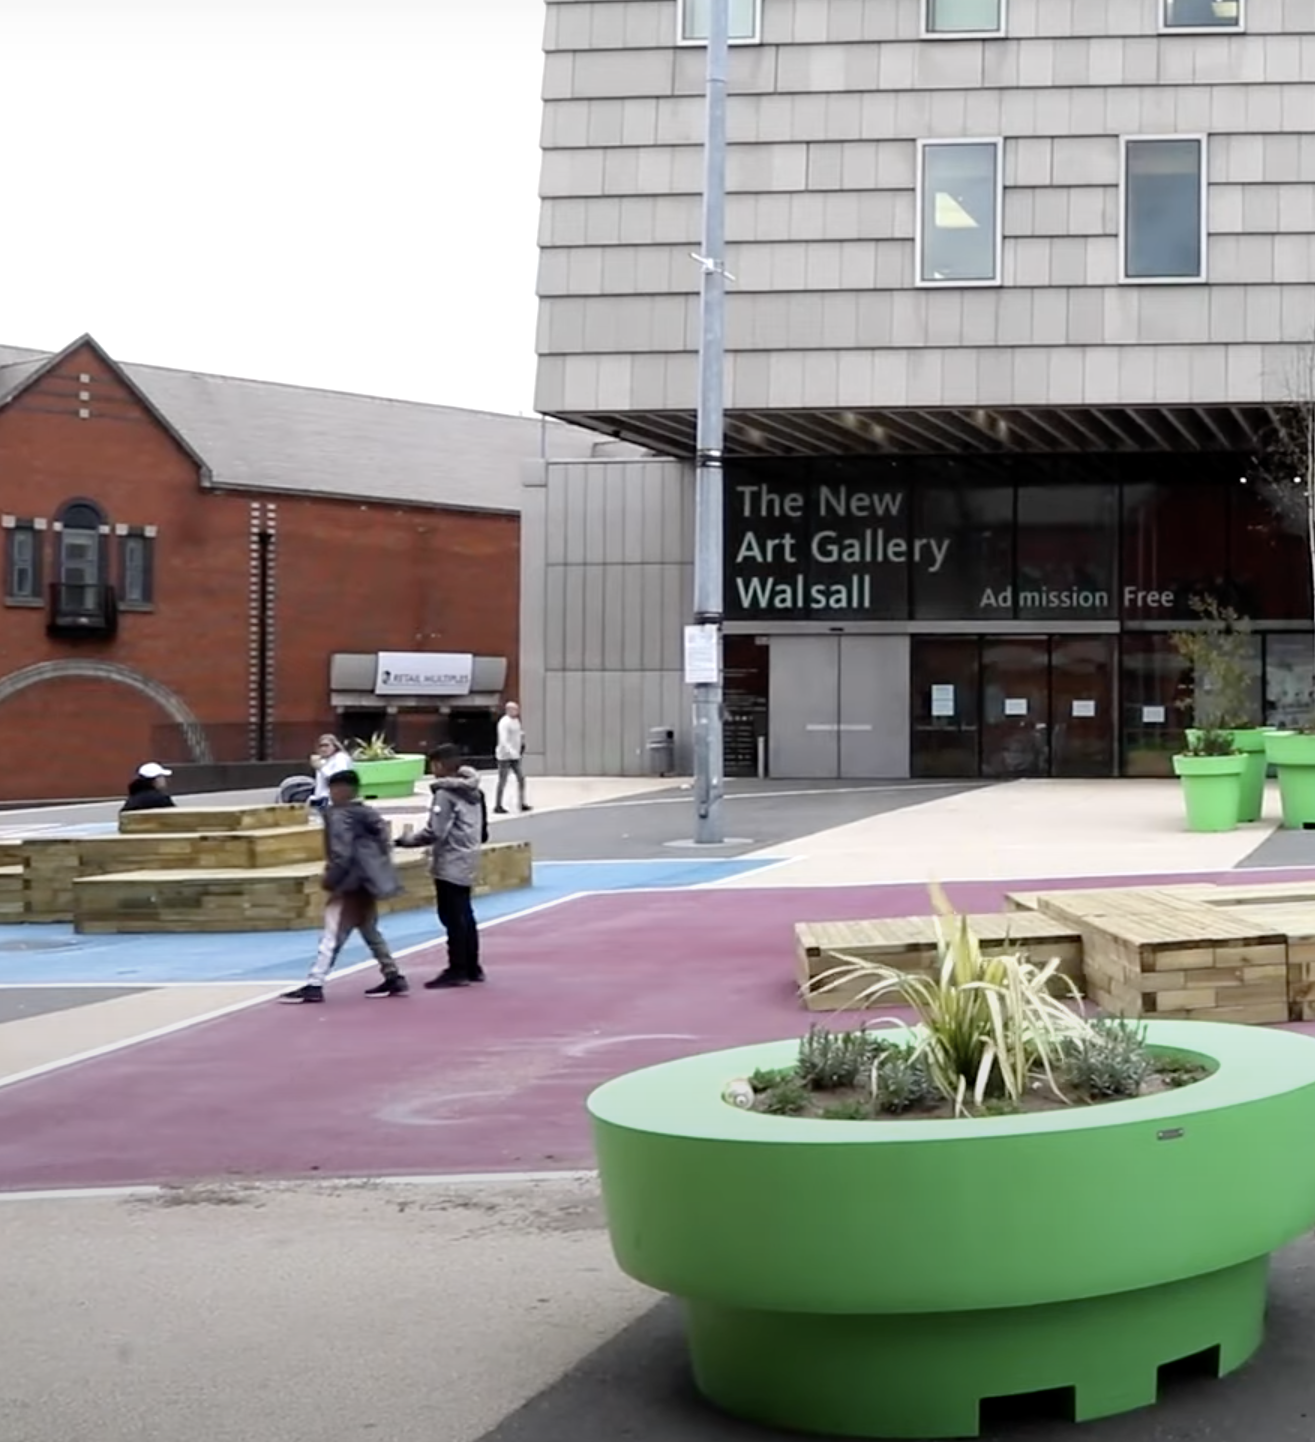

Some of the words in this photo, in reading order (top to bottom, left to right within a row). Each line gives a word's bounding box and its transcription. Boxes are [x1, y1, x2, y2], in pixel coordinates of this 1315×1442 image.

[736, 483, 804, 518] The
[819, 484, 903, 518] New
[735, 531, 797, 563] Art
[811, 528, 950, 573] Gallery
[735, 573, 871, 609] Walsall
[979, 586, 1109, 608] Admission
[1123, 586, 1175, 607] Free
